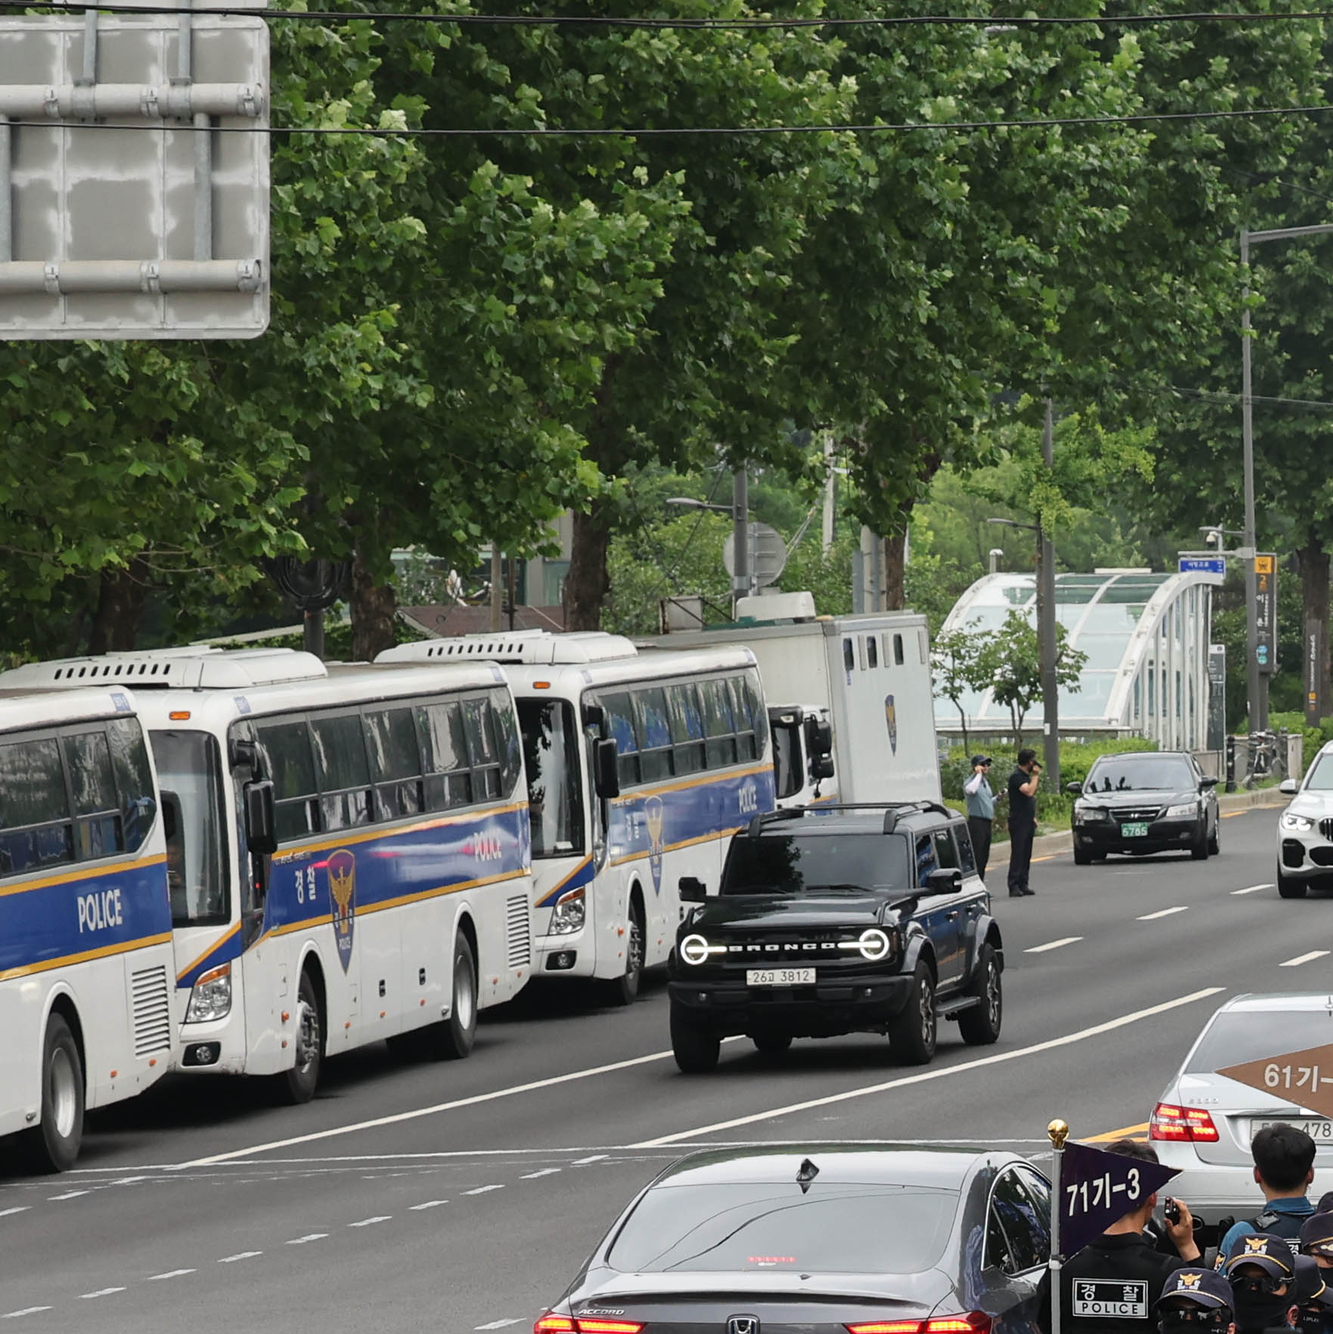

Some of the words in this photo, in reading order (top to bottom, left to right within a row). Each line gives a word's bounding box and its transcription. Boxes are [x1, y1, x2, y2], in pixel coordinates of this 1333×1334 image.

[738, 784, 757, 814] POLICE
[472, 829, 503, 863] POLICE
[294, 865, 317, 904] 경찰
[78, 889, 123, 933] POLICE
[729, 943, 835, 952] BRONCO
[780, 969, 810, 982] 3812
[1067, 1167, 1141, 1217] 71기-3
[1080, 1301, 1140, 1315] POLICE
